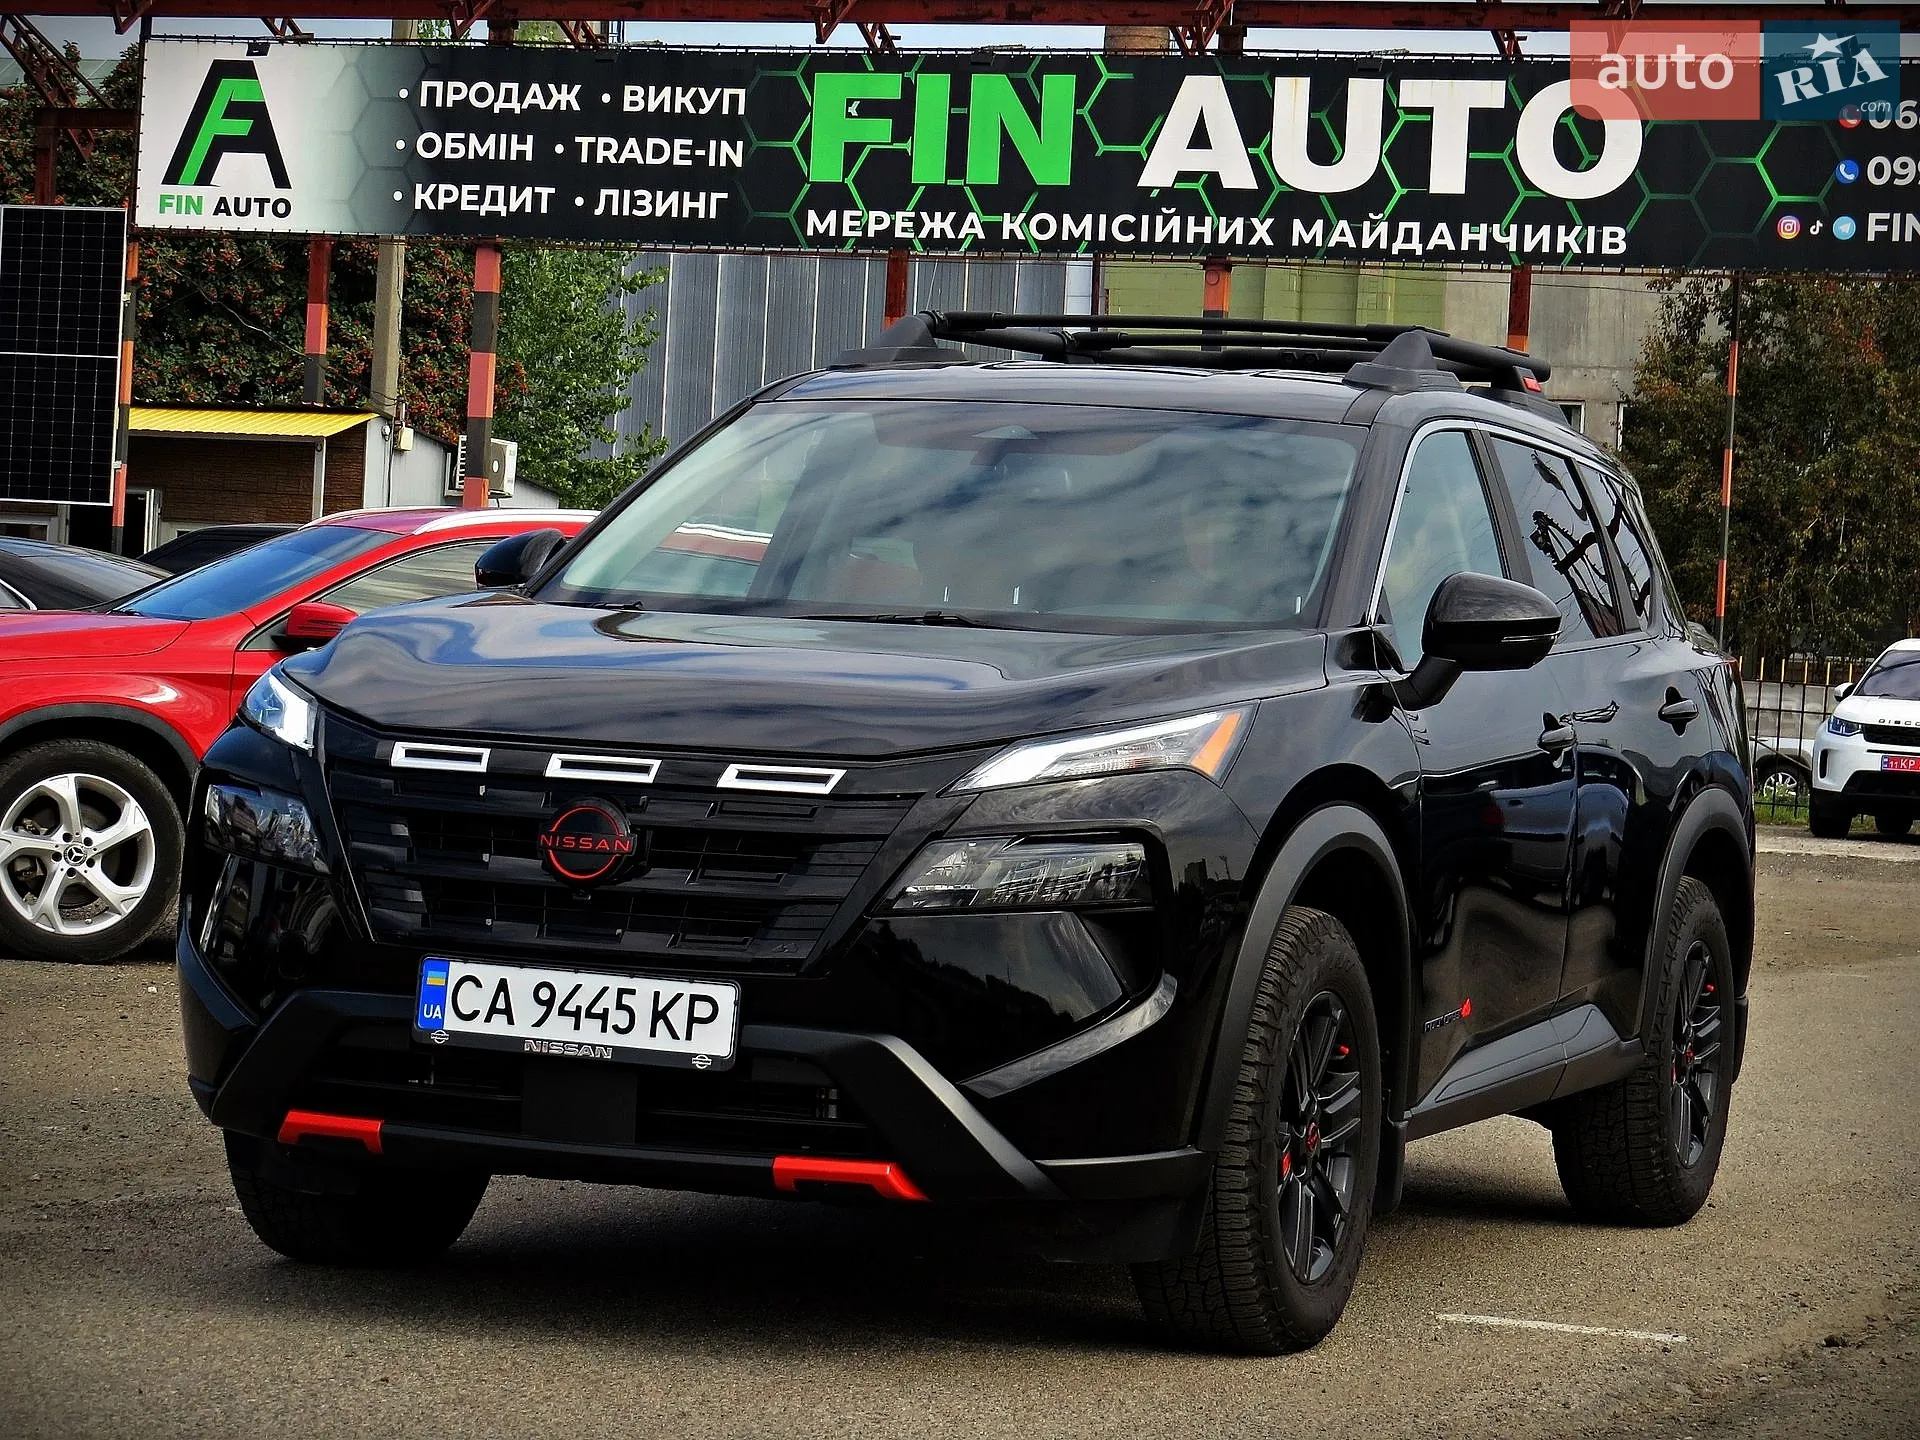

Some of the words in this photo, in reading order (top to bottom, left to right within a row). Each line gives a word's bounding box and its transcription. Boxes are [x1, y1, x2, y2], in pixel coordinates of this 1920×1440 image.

[420, 80, 582, 114] ПРОДАЖ
[622, 85, 747, 116] ВИКУП
[1868, 99, 1920, 129] 06
[415, 132, 534, 161] ОБМІН
[809, 72, 1077, 186] FIN
[1136, 75, 1643, 199] AUTO
[574, 136, 744, 167] TRADE-IN
[1867, 155, 1920, 186] 09
[159, 194, 203, 215] FIN
[212, 196, 292, 218] AUTO
[414, 183, 556, 217] КРЕДИТ
[594, 188, 729, 219] ЛІЗИНГ
[806, 209, 985, 241] МЕРЕЖА
[1002, 208, 1275, 246] КОМІСІЙНИХ
[1291, 212, 1627, 256] МАЙДАНЧИКІВ
[540, 833, 632, 852] NISSAN
[423, 1004, 442, 1019] UA
[451, 975, 515, 1026] CA
[531, 981, 636, 1035] 9445
[649, 990, 719, 1041] KP
[524, 1039, 612, 1059] NISSAN
